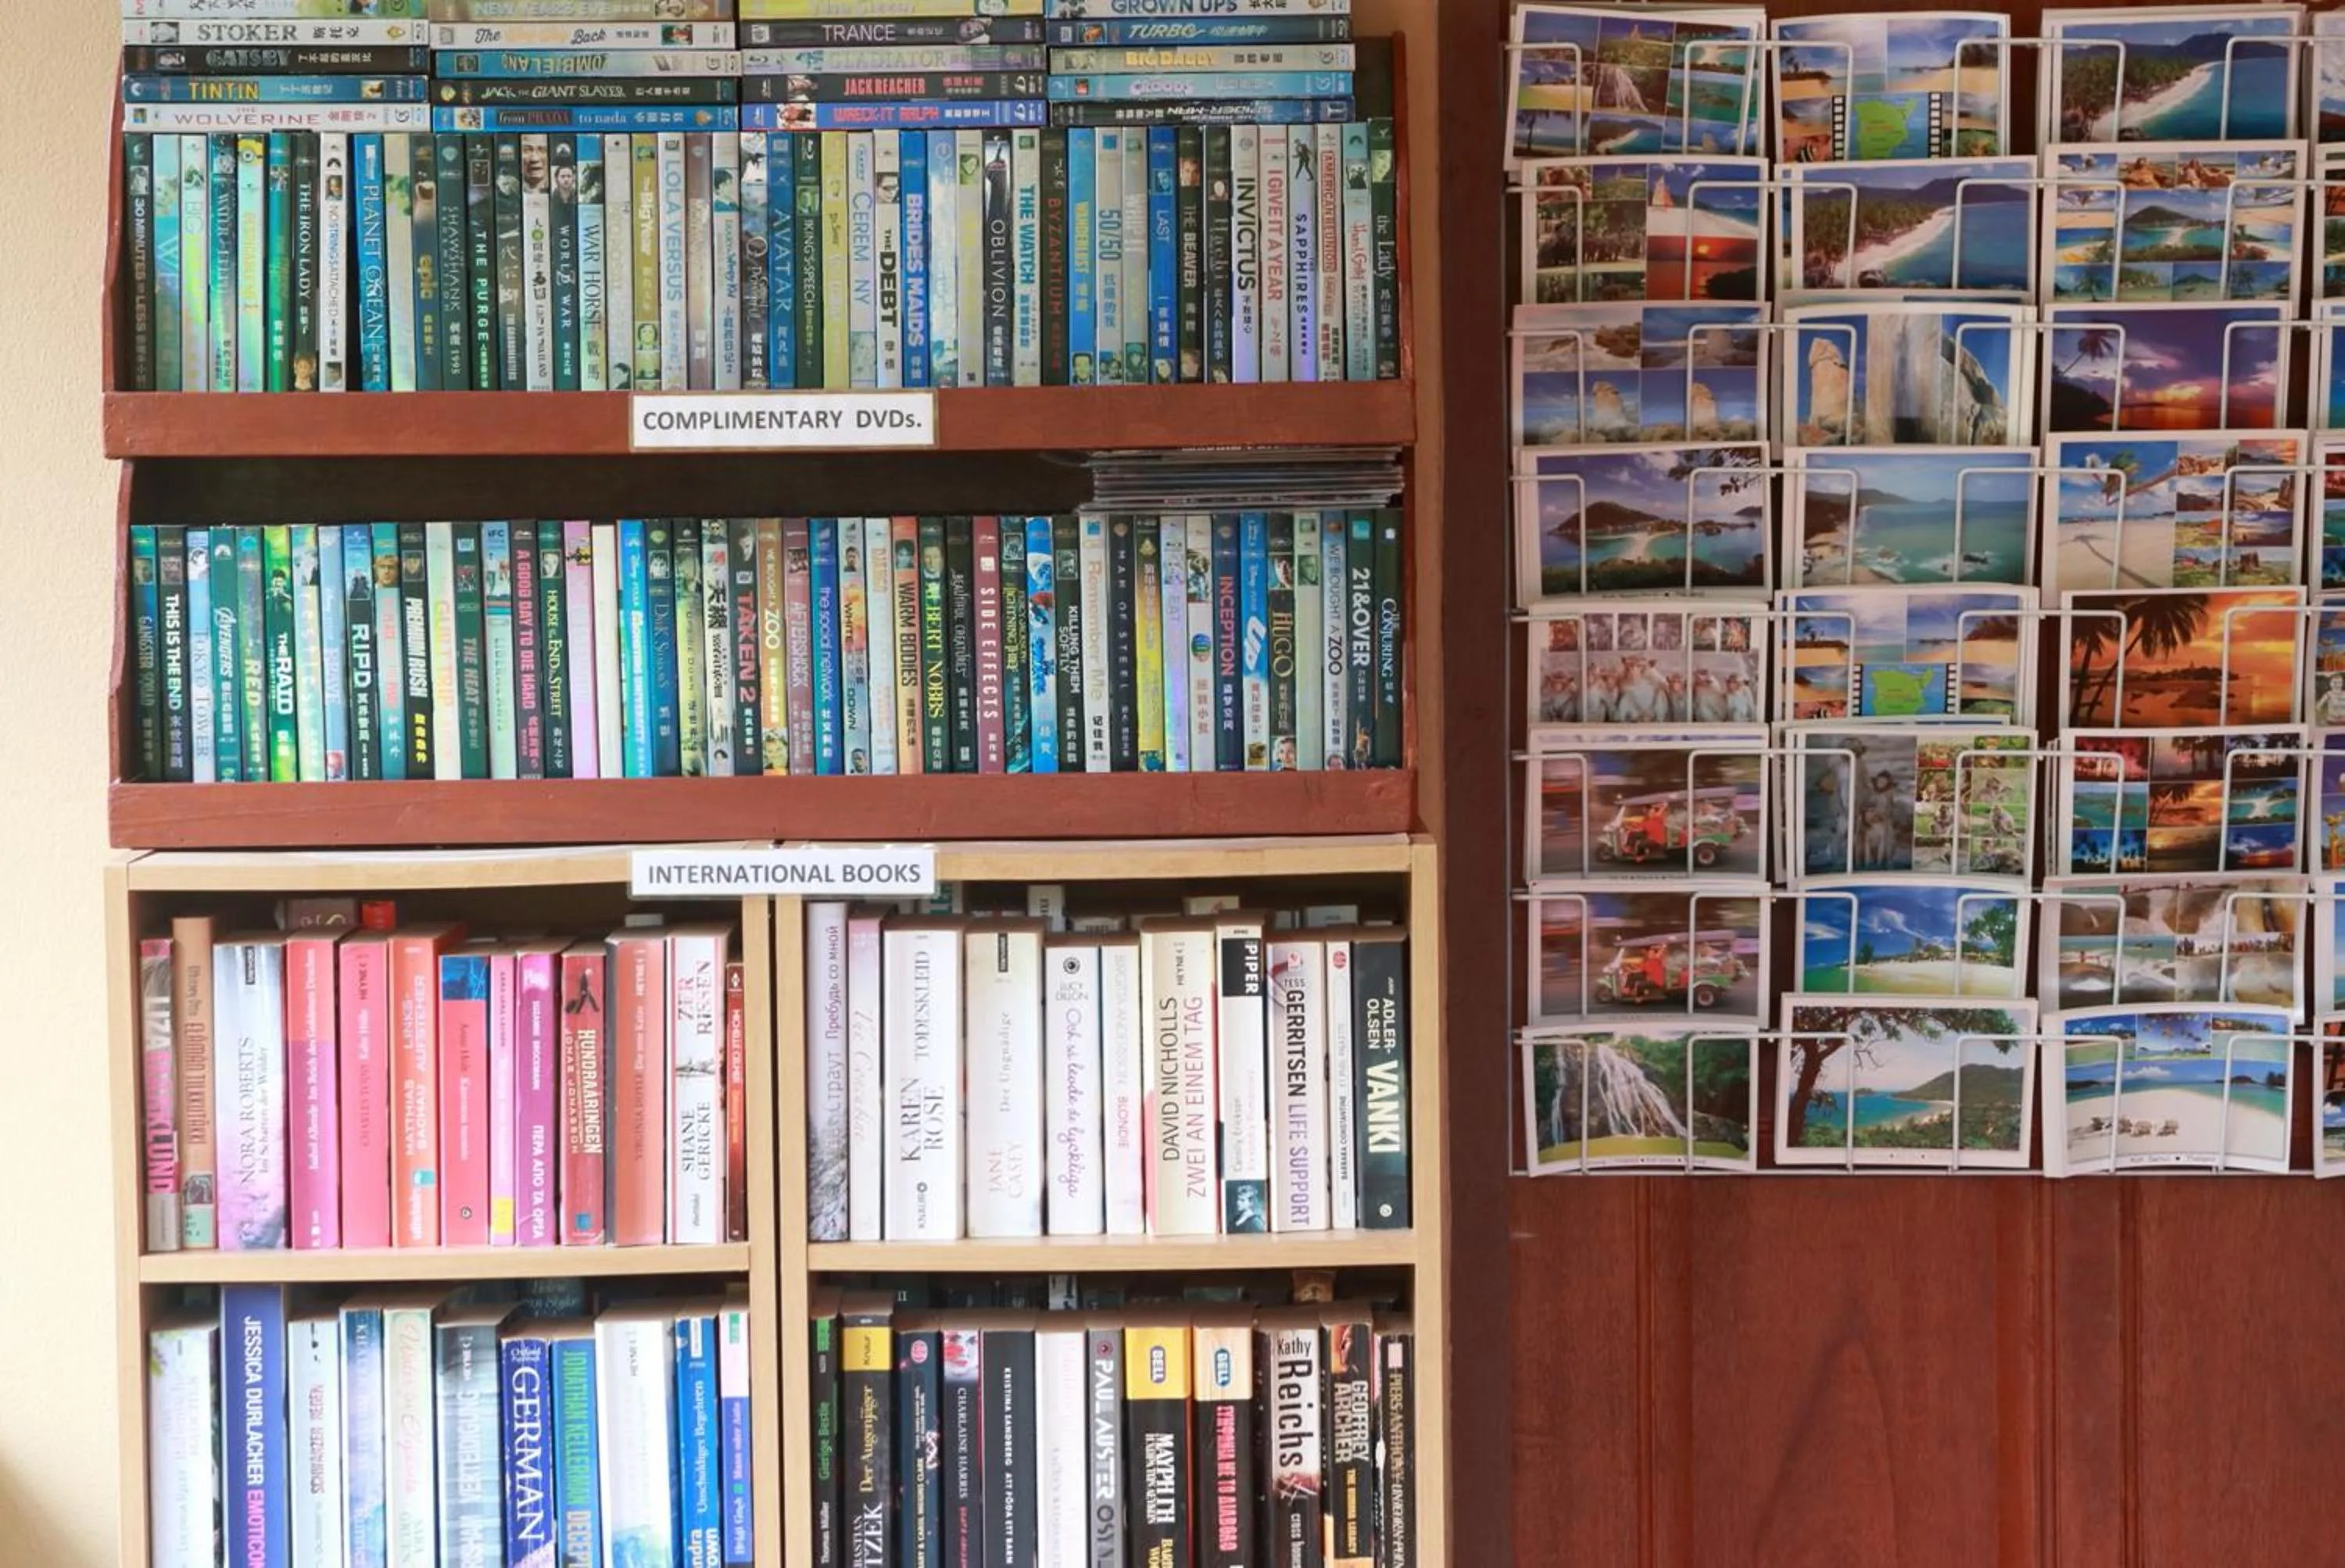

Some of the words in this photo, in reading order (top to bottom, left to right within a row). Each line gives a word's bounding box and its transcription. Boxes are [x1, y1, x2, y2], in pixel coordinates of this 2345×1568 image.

[198, 25, 298, 41] STOKER
[474, 28, 500, 43] The
[571, 29, 607, 45] Back
[822, 24, 896, 41] TRANCE
[1129, 23, 1206, 38] TURBO
[206, 49, 291, 66] GATSBY
[188, 81, 259, 100] TINTIN
[844, 78, 872, 95] JACK
[875, 78, 925, 95] REACHER
[175, 113, 320, 125] WOLVERINE
[299, 182, 311, 212] THE
[665, 159, 682, 216] LOLA
[1020, 185, 1035, 219] THE
[1268, 180, 1281, 217] GIVE
[299, 215, 311, 255] IRON
[363, 184, 380, 259] PLANET
[907, 194, 923, 273] BRIDES
[1099, 209, 1122, 260] 50/50
[1156, 209, 1169, 242] LAST
[1184, 205, 1195, 227] THE
[1237, 177, 1256, 290] INVICTUS
[1269, 220, 1281, 233] IT
[1377, 215, 1391, 234] the
[449, 206, 460, 311] SHAWSHANK
[476, 231, 487, 267] THE
[559, 224, 571, 284] WORLD
[583, 224, 601, 262] WAR
[666, 221, 682, 302] VERSUS
[775, 209, 792, 314] AVATAR
[1019, 224, 1035, 285] WATCH
[1047, 198, 1063, 317] BYZANTIUM
[1184, 232, 1197, 288] BEAVER
[1269, 241, 1282, 252] A
[1295, 213, 1308, 313] SAPPHIRES
[1373, 241, 1395, 280] Lady
[299, 259, 311, 299] LADY
[417, 255, 437, 299] epic
[880, 252, 897, 328] DEBT
[991, 219, 1006, 317] OBLIVION
[1268, 254, 1283, 301] YEAR
[364, 265, 384, 339] OCEAN
[477, 278, 489, 342] PURGE
[561, 295, 571, 329] WAR
[584, 270, 602, 330] HORSE
[908, 277, 923, 347] MAIDS
[643, 411, 842, 430] COMPLIMENTARY
[856, 410, 922, 428] DVDs.
[516, 550, 530, 560] A
[1329, 543, 1339, 563] WE
[517, 562, 532, 599] GOOD
[819, 587, 831, 607] the
[1329, 567, 1340, 621] BOUGHT
[166, 594, 179, 628] THIS
[406, 597, 425, 657] PREMIUM
[519, 601, 533, 627] DAY
[547, 590, 561, 628] HOUSE
[898, 582, 915, 628] WARM
[980, 587, 996, 630] SIDE
[1087, 560, 1103, 664] Remember
[1219, 576, 1234, 676] INCEPTION
[1352, 567, 1369, 667] 21&OVER
[166, 631, 180, 645] IS
[278, 632, 288, 657] THE
[463, 637, 477, 664] THE
[520, 630, 533, 648] TO
[736, 591, 756, 680] TAKEN
[789, 601, 809, 689] AFTERSHOCK
[820, 611, 832, 648] social
[1058, 626, 1069, 673] SOFTLY
[1069, 606, 1079, 656] KILLING
[1272, 610, 1294, 678] HUGO
[1330, 625, 1340, 635] A
[1380, 598, 1398, 677] CONJURING
[166, 647, 181, 678] THE
[194, 630, 209, 689] TOKYO
[521, 650, 534, 671] DIE
[549, 639, 564, 668] END
[821, 650, 834, 702] network
[900, 633, 918, 687] BODIES
[1069, 658, 1080, 693] THEM
[1328, 636, 1343, 676] ZOO
[167, 678, 181, 710] END
[245, 659, 261, 707] RED
[277, 657, 293, 714] RAID
[409, 658, 428, 697] RUSH
[464, 668, 479, 705] HEAT
[521, 673, 535, 710] HARD
[550, 677, 562, 719] STREET
[740, 686, 756, 703] 2
[982, 640, 998, 720] EFFECTS
[1090, 668, 1105, 701] Me
[195, 696, 209, 757] TOWER
[649, 865, 834, 883] INTERNATIONAL
[843, 865, 922, 883] BOOKS
[827, 925, 839, 961] мной
[829, 964, 838, 980] со
[1245, 944, 1259, 993] PIPER
[825, 983, 840, 1040] Пребудь
[1184, 997, 1202, 1034] TAG
[1366, 998, 1380, 1050] OLSEN
[1383, 998, 1395, 1054] ADLER-
[564, 1028, 575, 1073] JONAS
[1159, 997, 1179, 1096] NICHOLLS
[1286, 990, 1306, 1097] GERRITSEN
[237, 1037, 252, 1124] ROBERTS
[1185, 1041, 1203, 1105] EINEM
[404, 1079, 414, 1156] MATTHIAS
[900, 1077, 922, 1165] KAREN
[922, 1087, 943, 1151] ROSE
[1118, 1096, 1129, 1150] BLONDIE
[1186, 1112, 1203, 1140] AN
[1288, 1104, 1308, 1140] LIFE
[1366, 1060, 1400, 1154] VANKI
[681, 1112, 694, 1172] SHANE
[696, 1101, 711, 1181] GERICKE
[1161, 1102, 1180, 1162] DAVID
[238, 1129, 255, 1187] NORA
[1186, 1147, 1203, 1198] ZWEI
[1289, 1146, 1310, 1225] SUPPORT
[243, 1316, 263, 1385] JESSICA
[1151, 1350, 1166, 1381] BELL
[1216, 1352, 1229, 1384] BELL
[1277, 1338, 1312, 1357] Kathy
[563, 1351, 589, 1419] JONATHAN
[1388, 1373, 1402, 1409] PIERS
[245, 1388, 264, 1486] DURLACHER
[958, 1387, 968, 1454] CHARLAINE
[1278, 1360, 1313, 1468] Reichs
[1334, 1382, 1352, 1464] ARCHER
[1352, 1380, 1369, 1462] GEOFFREY
[512, 1366, 545, 1541] GERMAN
[565, 1424, 591, 1505] KELLERMAN
[1156, 1433, 1174, 1494] ΜΑΥΡΗ
[1389, 1412, 1404, 1481] ANTHONY
[958, 1455, 969, 1499] HARRIS
